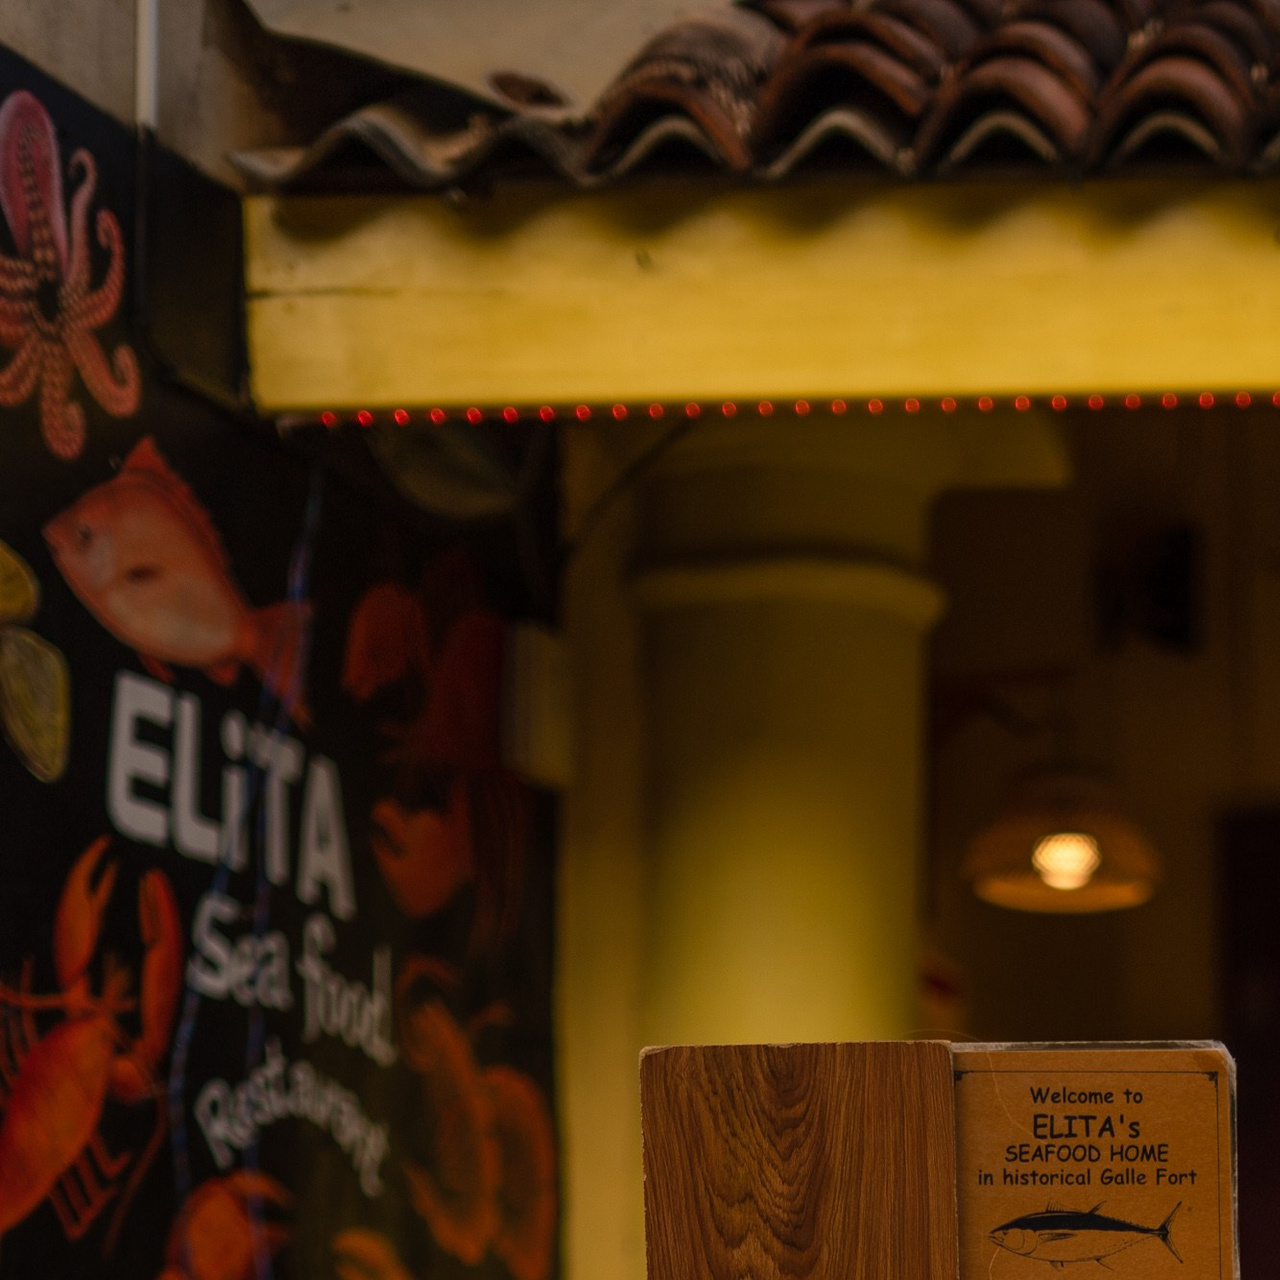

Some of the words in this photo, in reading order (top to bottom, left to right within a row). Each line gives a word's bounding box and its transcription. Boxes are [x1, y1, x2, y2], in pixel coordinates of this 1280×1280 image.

[193, 893, 293, 1010] Sea
[296, 913, 395, 1066] food
[1029, 1086, 1114, 1104] Welcome
[1123, 1088, 1143, 1104] to
[1033, 1113, 1140, 1139] ELITA's
[1004, 1143, 1101, 1163] SEAFOOD
[1110, 1143, 1168, 1163] HOME
[978, 1169, 993, 1186] in
[1003, 1167, 1091, 1186] historical
[1100, 1167, 1147, 1186] Galle
[1156, 1167, 1197, 1185] Fort
